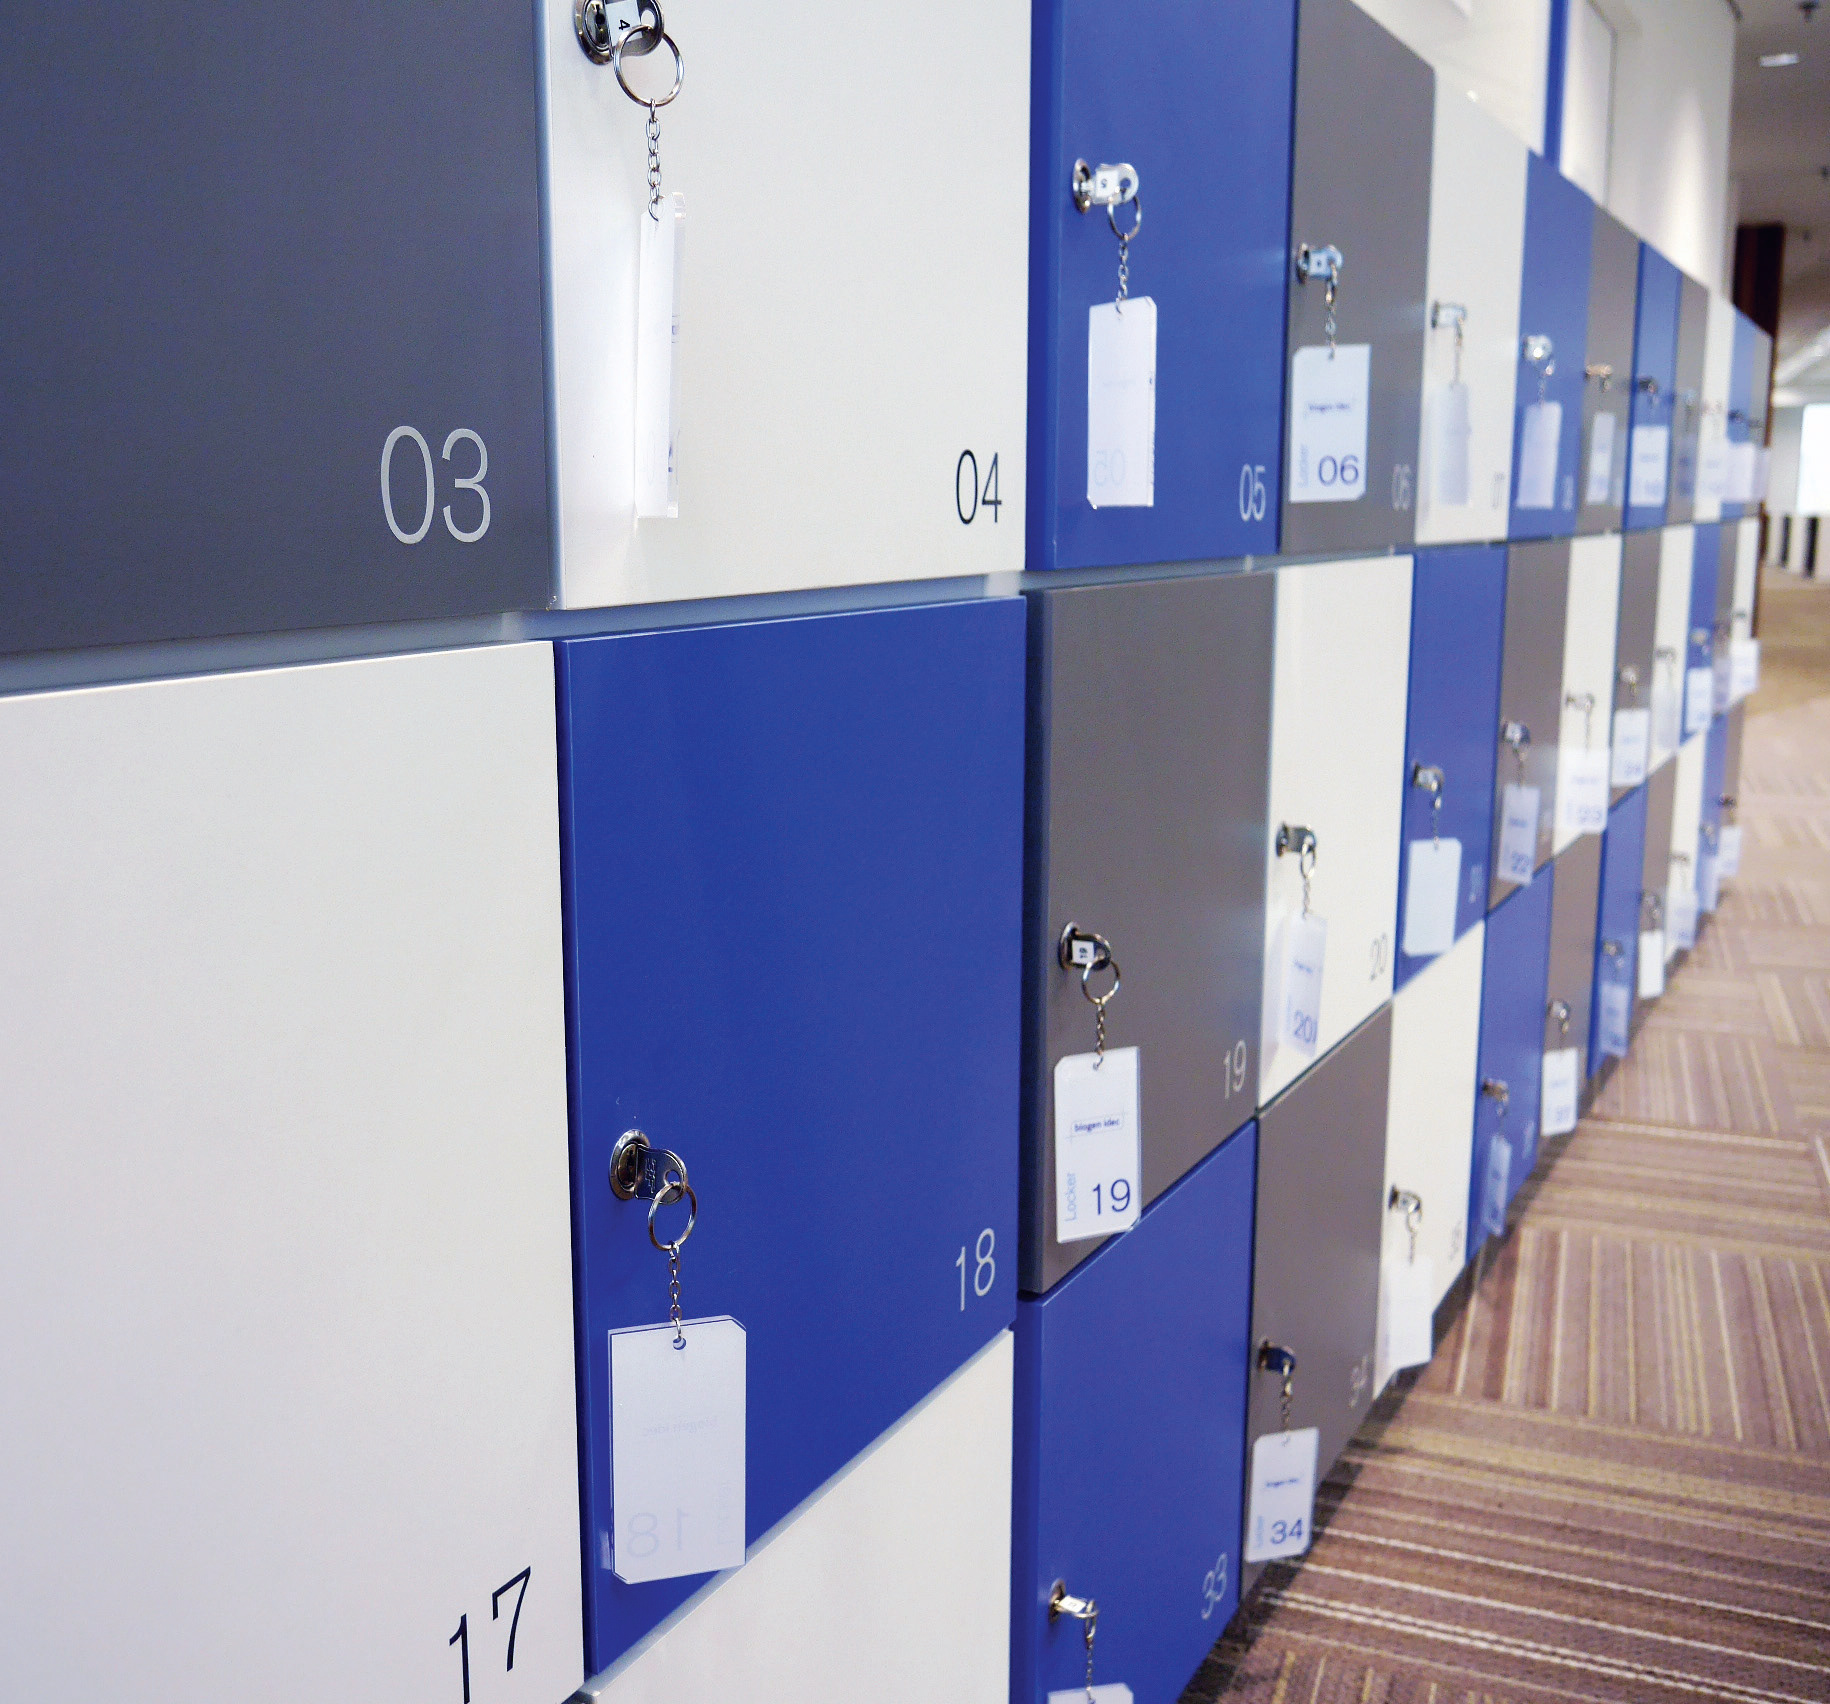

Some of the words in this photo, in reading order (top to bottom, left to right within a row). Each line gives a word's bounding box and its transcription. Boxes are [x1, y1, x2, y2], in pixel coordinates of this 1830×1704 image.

[618, 19, 631, 31] 4
[380, 425, 491, 545] 03
[956, 449, 1002, 525] 04
[1239, 464, 1266, 521] 05
[1318, 454, 1359, 487] 06
[1294, 1008, 1313, 1044] 20
[1223, 1039, 1247, 1100] 19
[1092, 1179, 1131, 1216] 19
[956, 1228, 996, 1311] 18
[1271, 1518, 1303, 1545] 34
[1201, 1552, 1228, 1620] 33
[449, 1566, 531, 1704] 17
